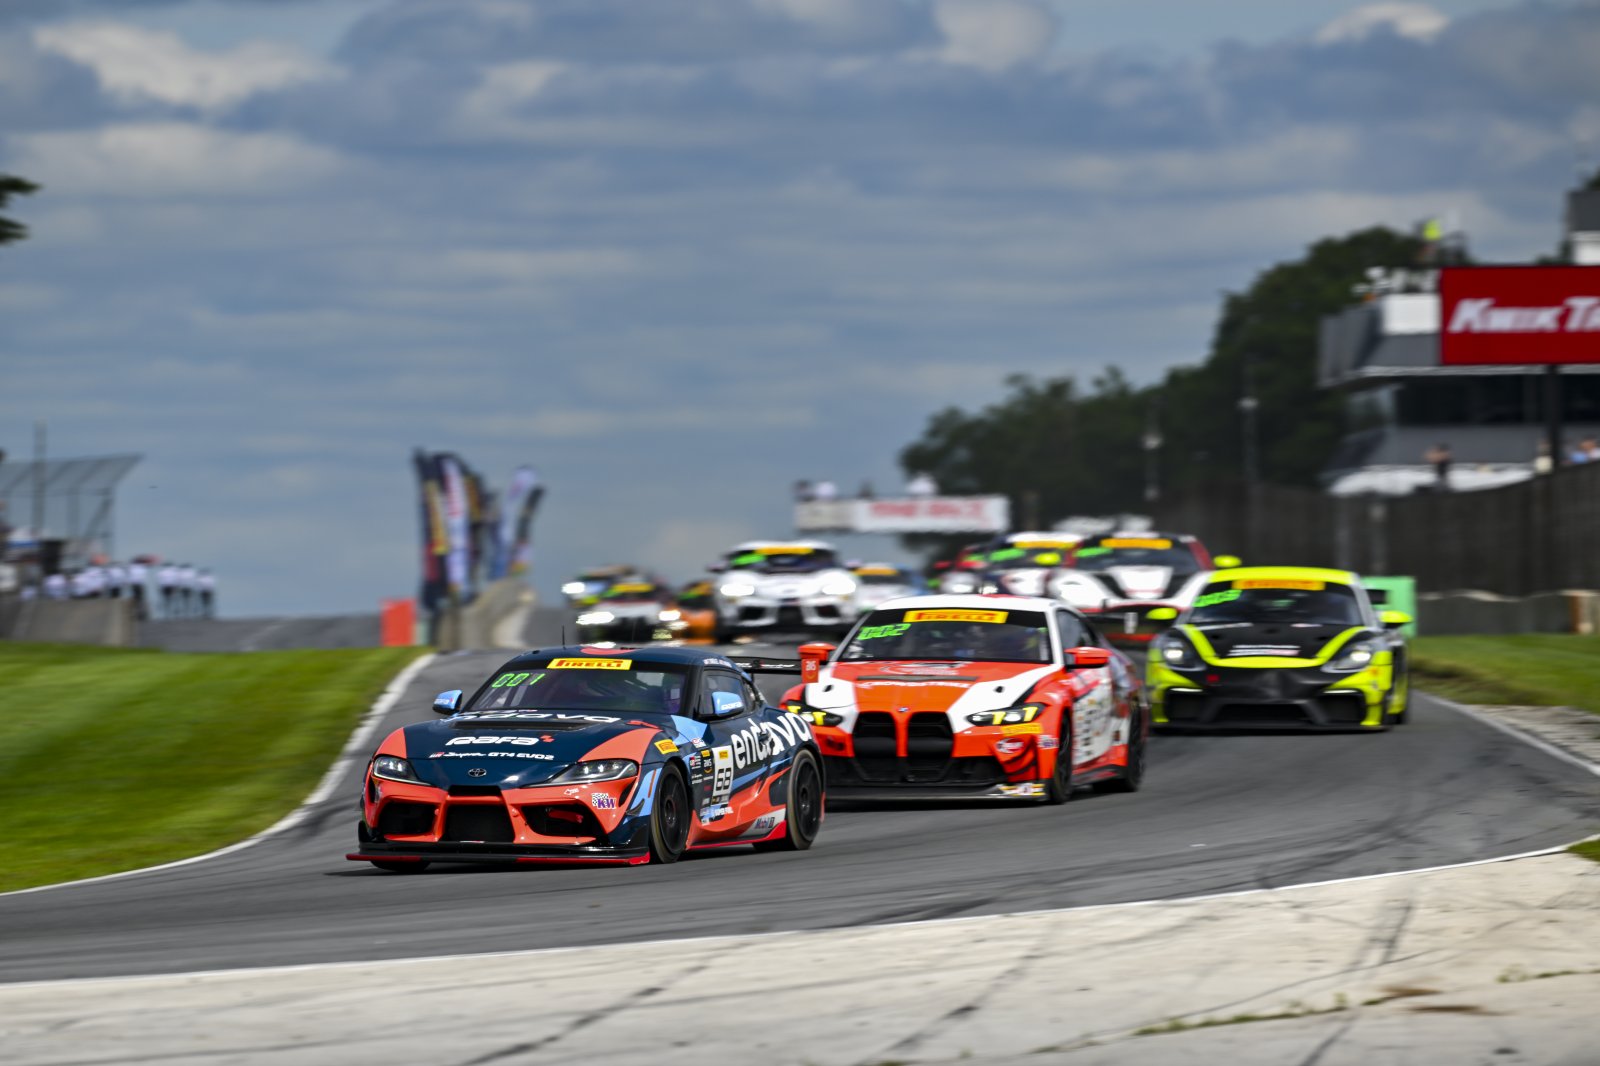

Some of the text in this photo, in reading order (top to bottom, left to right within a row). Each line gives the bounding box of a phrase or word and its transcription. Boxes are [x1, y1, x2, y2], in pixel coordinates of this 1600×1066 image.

[915, 611, 995, 622] PIRELLI
[858, 624, 911, 640] 002
[555, 660, 623, 668] PIRELLI
[491, 672, 545, 688] 001
[731, 713, 812, 769] endava
[517, 752, 554, 760] EVO2
[597, 799, 614, 808] KW
